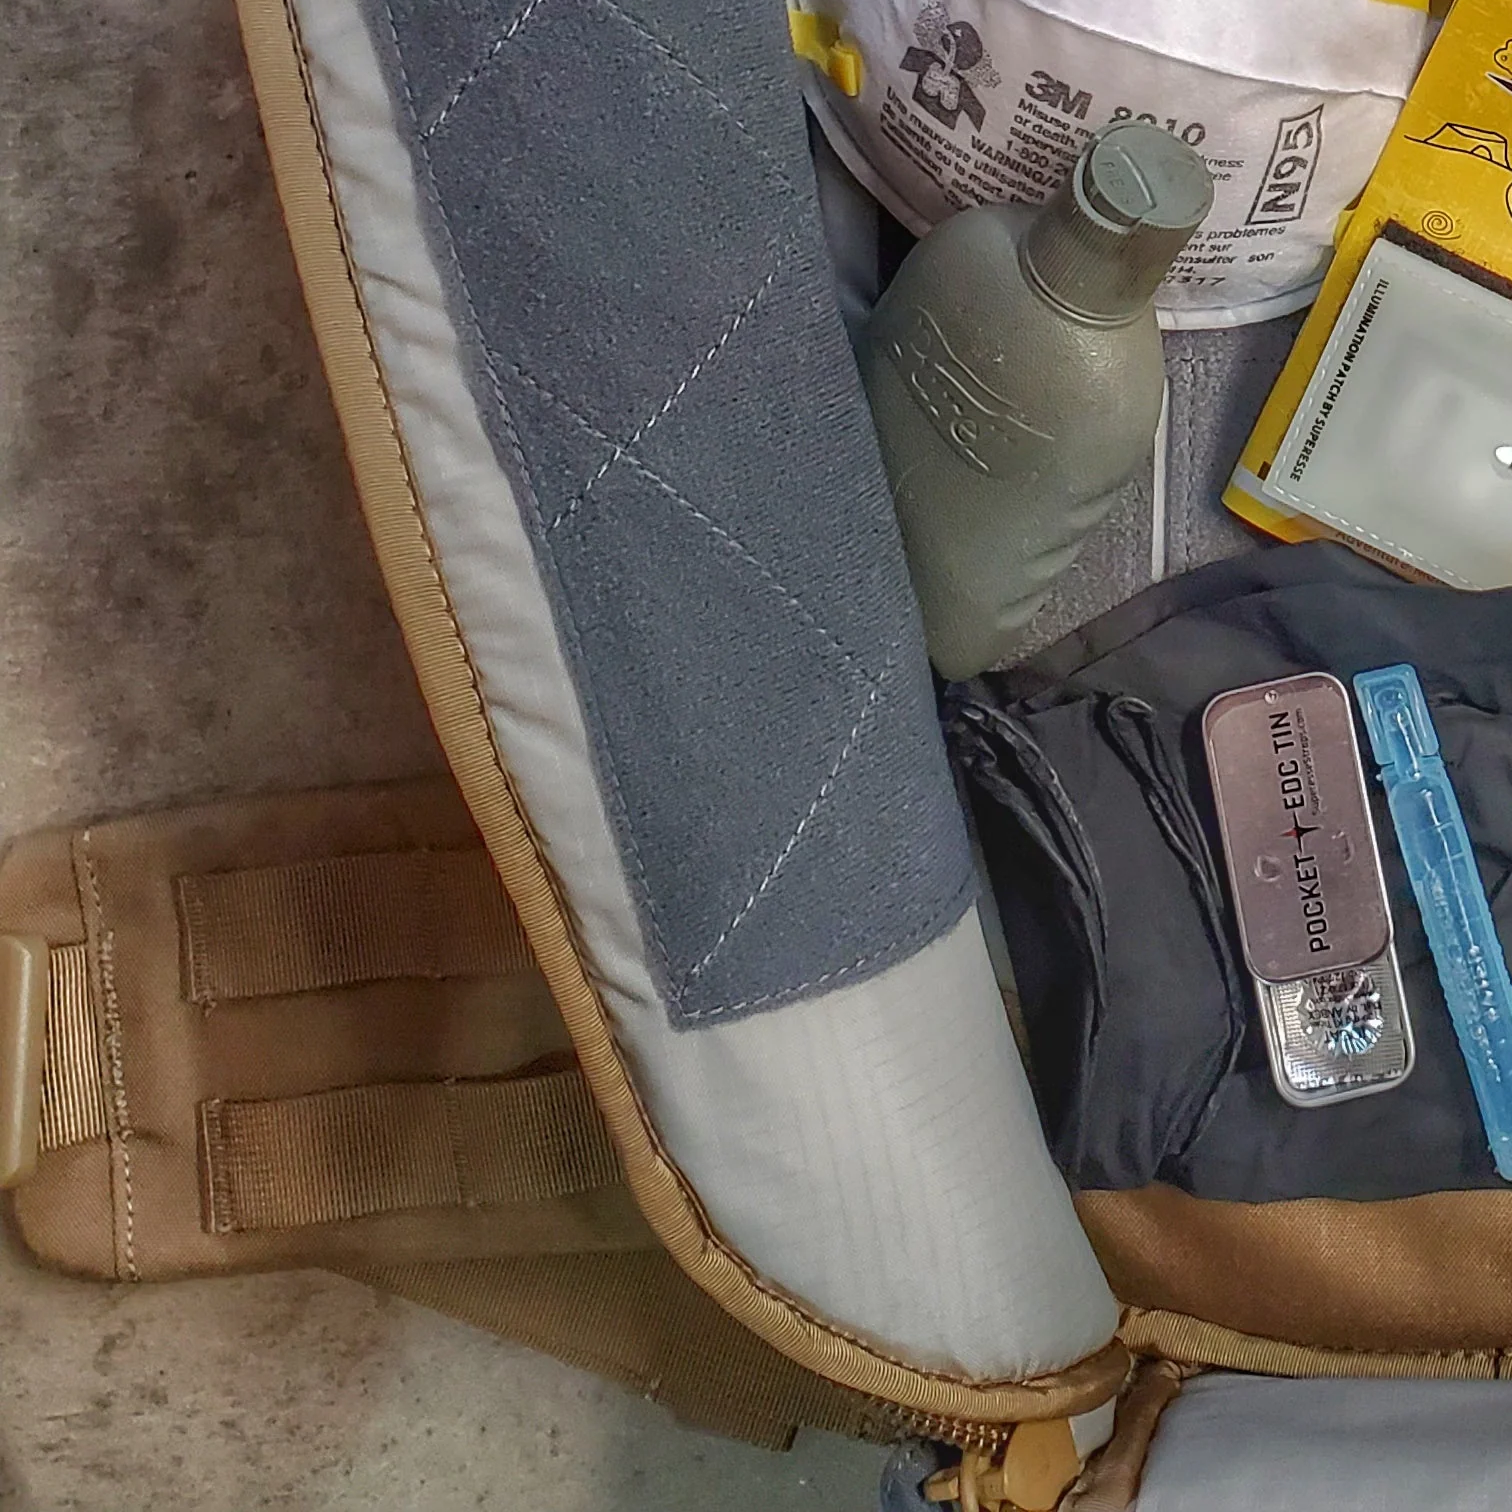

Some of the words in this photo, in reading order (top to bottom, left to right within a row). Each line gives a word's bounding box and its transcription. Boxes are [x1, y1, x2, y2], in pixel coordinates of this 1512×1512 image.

[1018, 98, 1071, 132] Misuse
[1025, 70, 1093, 120] 3M
[887, 87, 908, 115] Une
[910, 114, 970, 163] mauvaise
[974, 157, 1045, 200] utilisation
[1013, 114, 1031, 128] or
[1032, 121, 1077, 149] death.
[935, 149, 951, 166] ou
[971, 135, 1061, 189] WARNING/A
[1203, 155, 1244, 168] ness
[1260, 122, 1314, 213] N95
[1248, 252, 1274, 263] son
[1344, 279, 1390, 363] ILLUMINATION
[1326, 361, 1351, 403] PATCH
[1319, 401, 1334, 418] BY
[1290, 417, 1326, 482] SUPERESSE
[1269, 711, 1295, 754] TIN
[1278, 759, 1305, 810] EDC
[1293, 854, 1330, 952] POCKET
